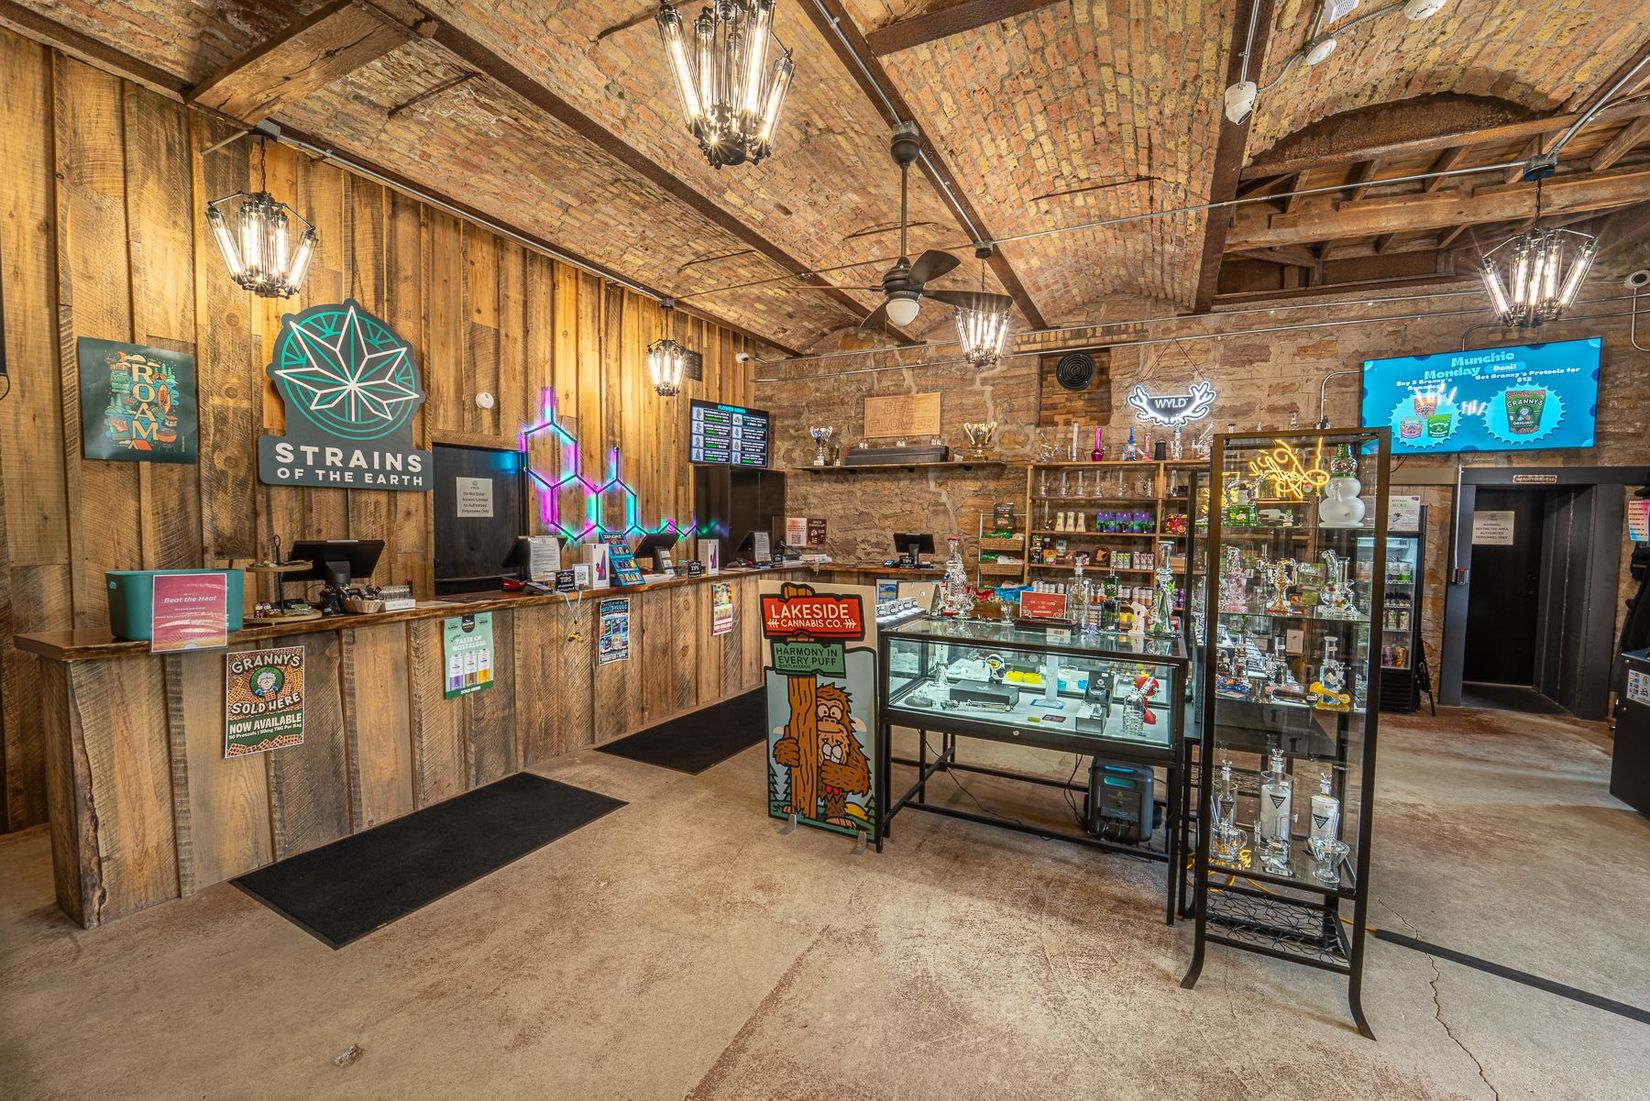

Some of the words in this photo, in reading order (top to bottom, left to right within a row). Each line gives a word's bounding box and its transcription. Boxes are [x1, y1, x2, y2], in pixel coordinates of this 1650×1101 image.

[1451, 351, 1515, 367] Munchie
[1424, 367, 1481, 379] Monday
[131, 363, 158, 440] ROAM
[1154, 398, 1187, 409] WYLD
[275, 442, 422, 473] STRAINS
[276, 467, 304, 480] OF
[315, 469, 354, 483] THE
[364, 472, 423, 487] EARTH
[560, 575, 572, 583] TIPS
[771, 604, 850, 619] LAKESIDE
[781, 619, 824, 628] CANNABIS
[826, 620, 842, 628] CO.
[776, 646, 824, 657] HARMONY
[827, 648, 838, 657] IN
[232, 653, 300, 674] GRANNY'S
[778, 655, 809, 666] EVERY
[812, 657, 837, 667] PUFF
[231, 702, 266, 714] SOLD
[268, 692, 300, 711] HERE
[229, 721, 252, 735] NOW
[254, 713, 302, 730] AVAILABLE
